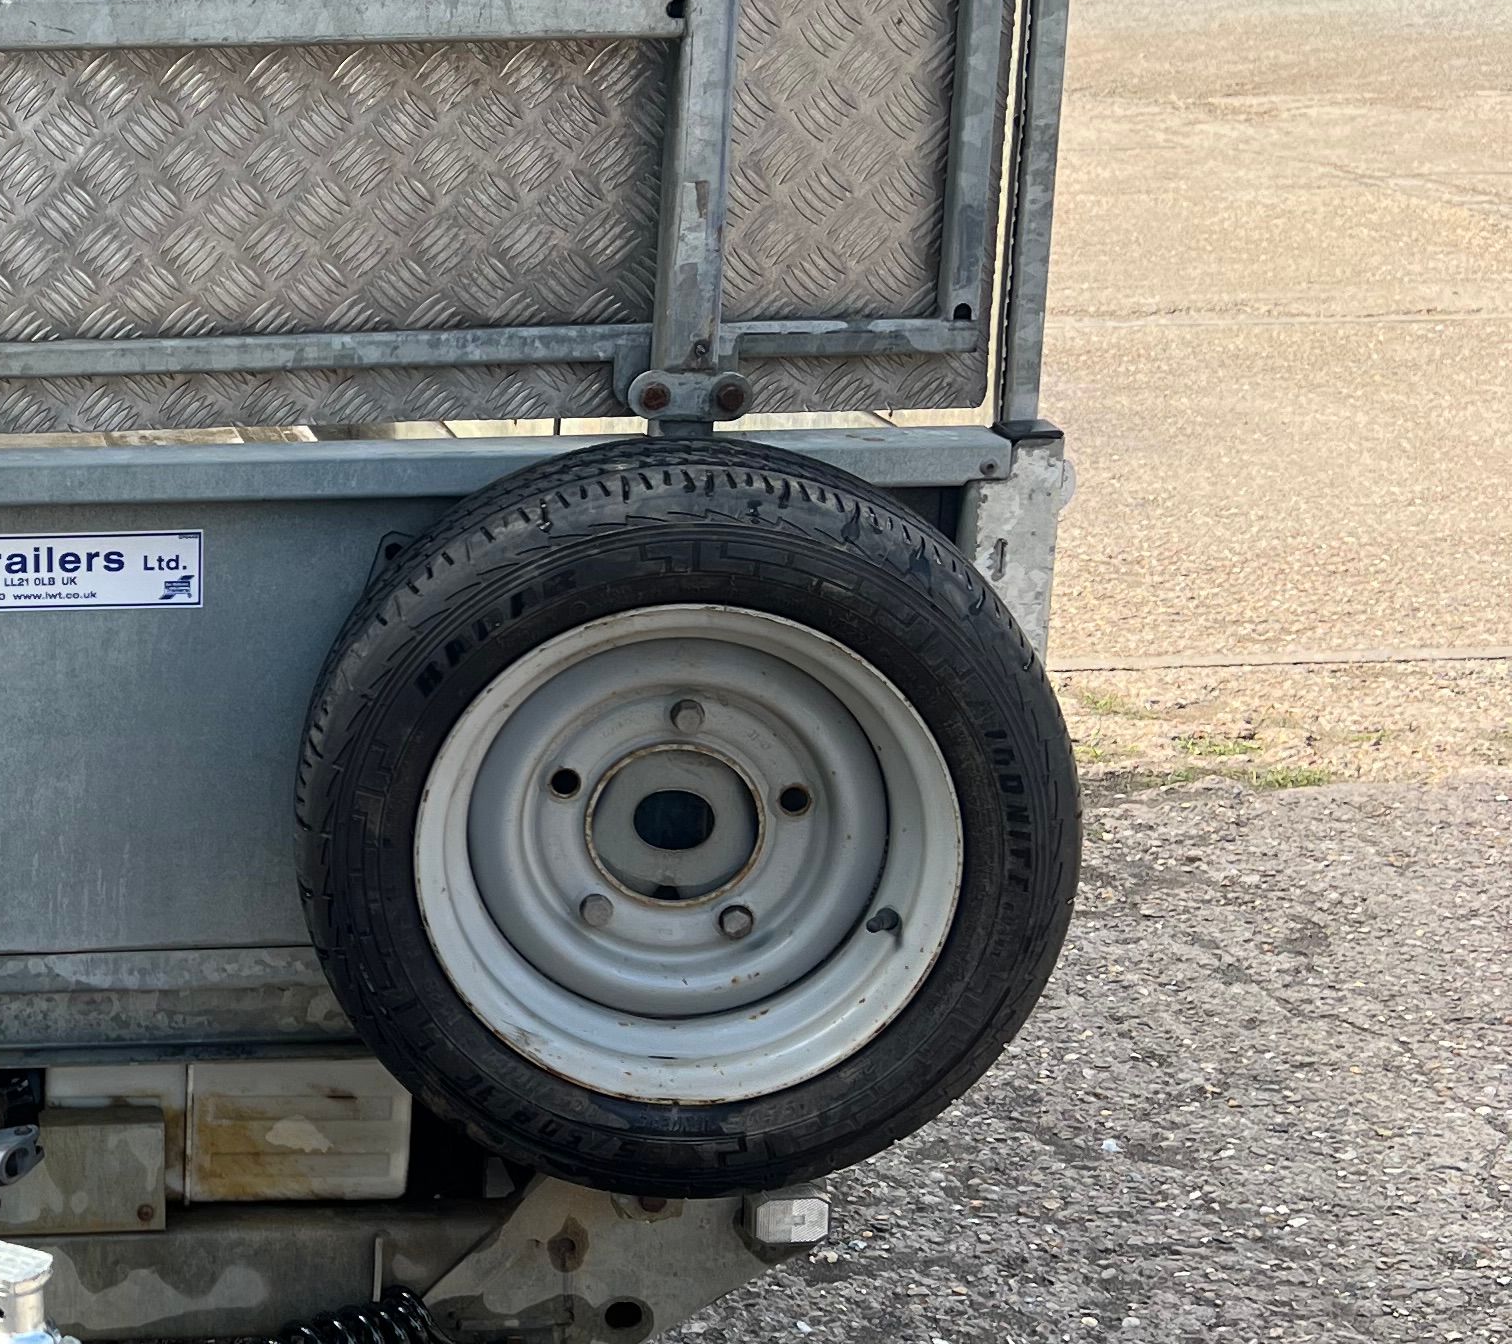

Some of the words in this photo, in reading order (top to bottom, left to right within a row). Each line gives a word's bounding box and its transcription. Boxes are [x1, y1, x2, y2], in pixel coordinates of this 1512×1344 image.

[143, 554, 187, 571] Ltd.
[4, 577, 29, 587] LL21
[62, 576, 77, 586] UK
[13, 591, 97, 600] www.iwt.co.uk
